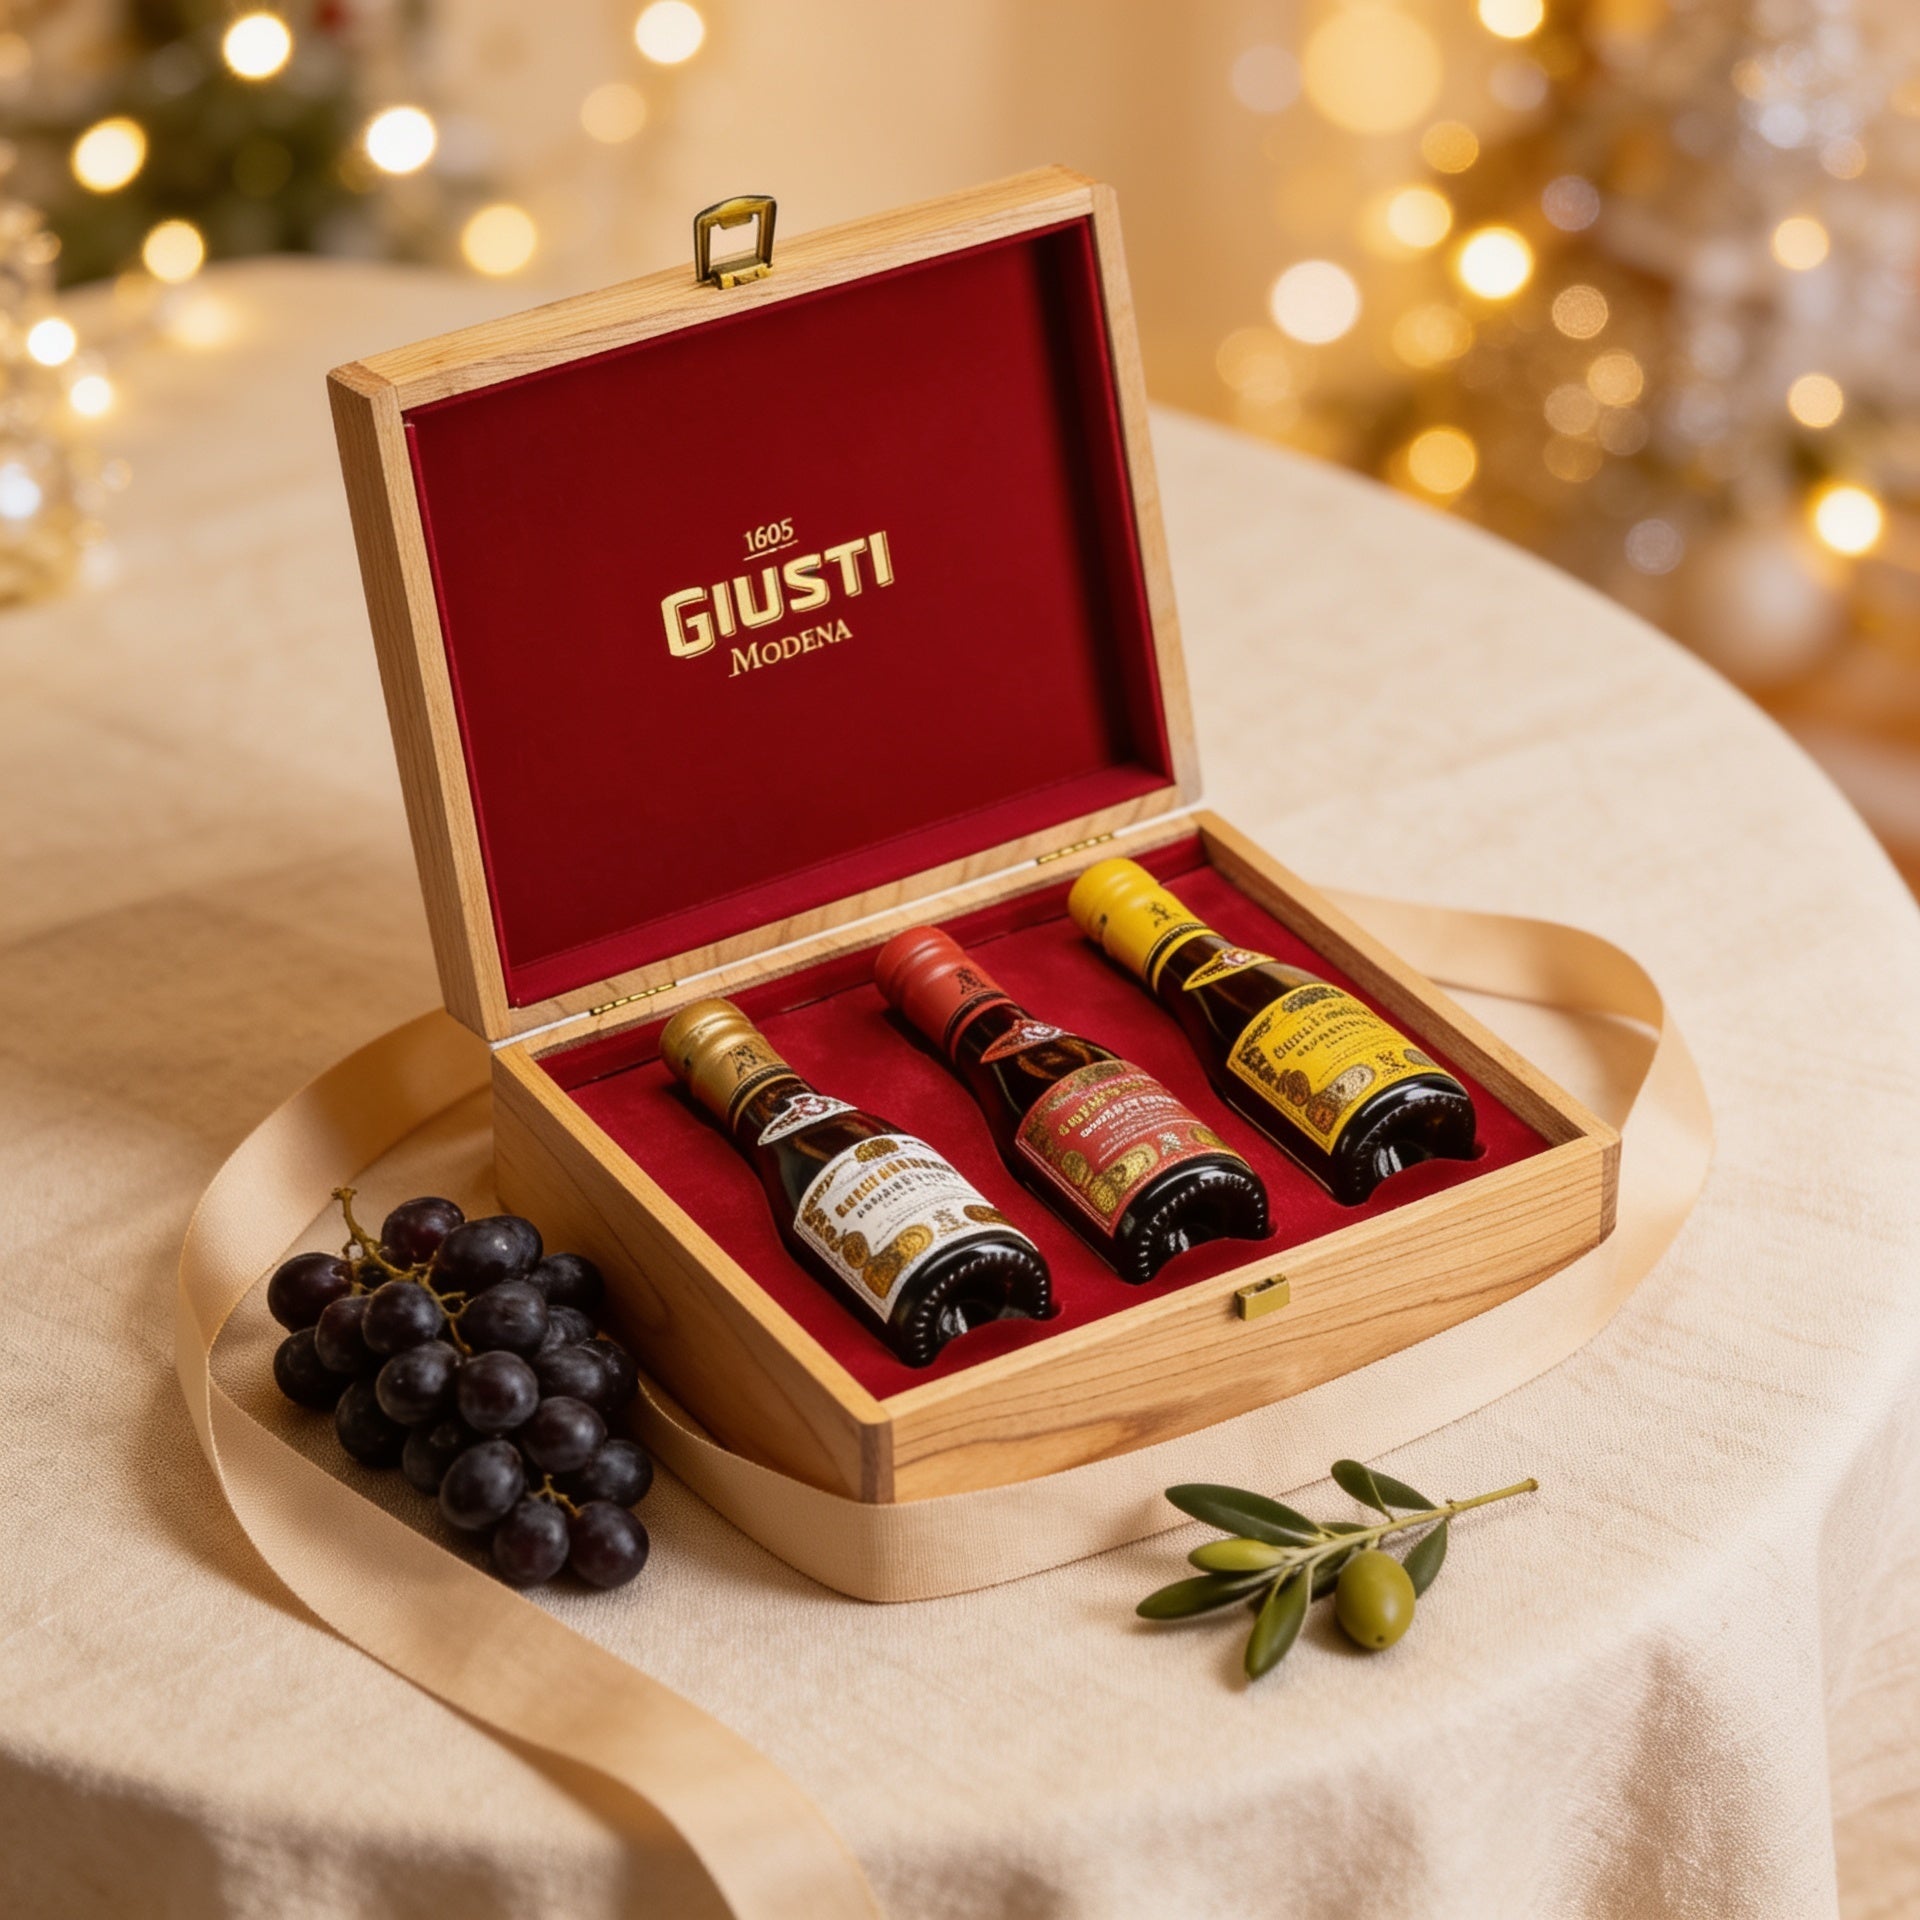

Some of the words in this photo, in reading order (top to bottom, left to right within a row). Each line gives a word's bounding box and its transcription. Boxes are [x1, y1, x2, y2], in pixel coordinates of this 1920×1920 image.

[744, 517, 794, 553] 1605
[661, 530, 894, 659] GIUSTI
[728, 618, 853, 678] MODENA
